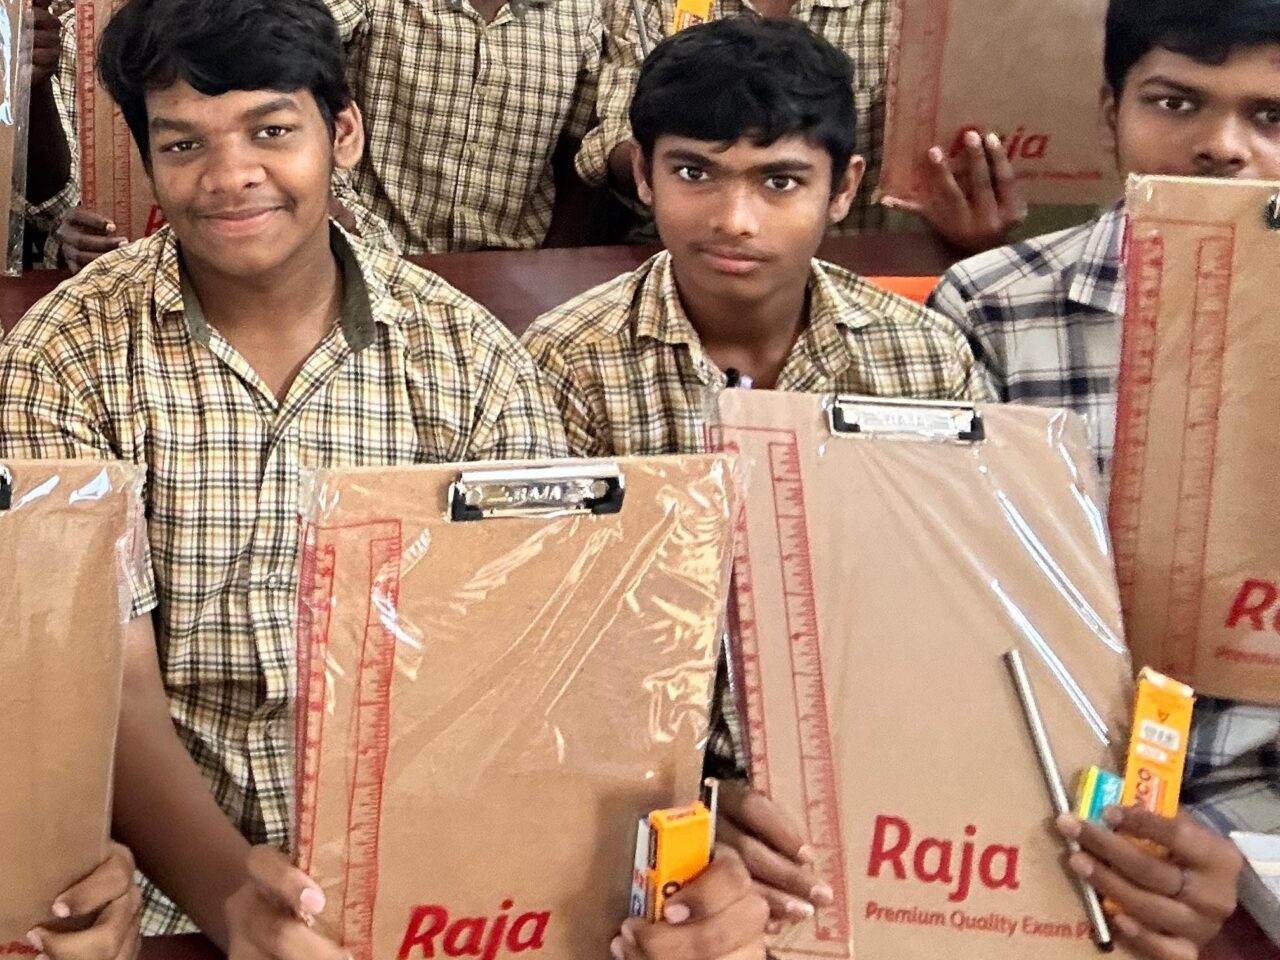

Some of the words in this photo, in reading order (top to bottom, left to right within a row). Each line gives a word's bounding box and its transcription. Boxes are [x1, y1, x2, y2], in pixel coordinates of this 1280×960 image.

[867, 814, 1020, 902] Raja
[396, 899, 552, 960] Raja
[865, 901, 945, 927] Premium
[950, 910, 1017, 936] Quality
[1022, 916, 1073, 937] Exam
